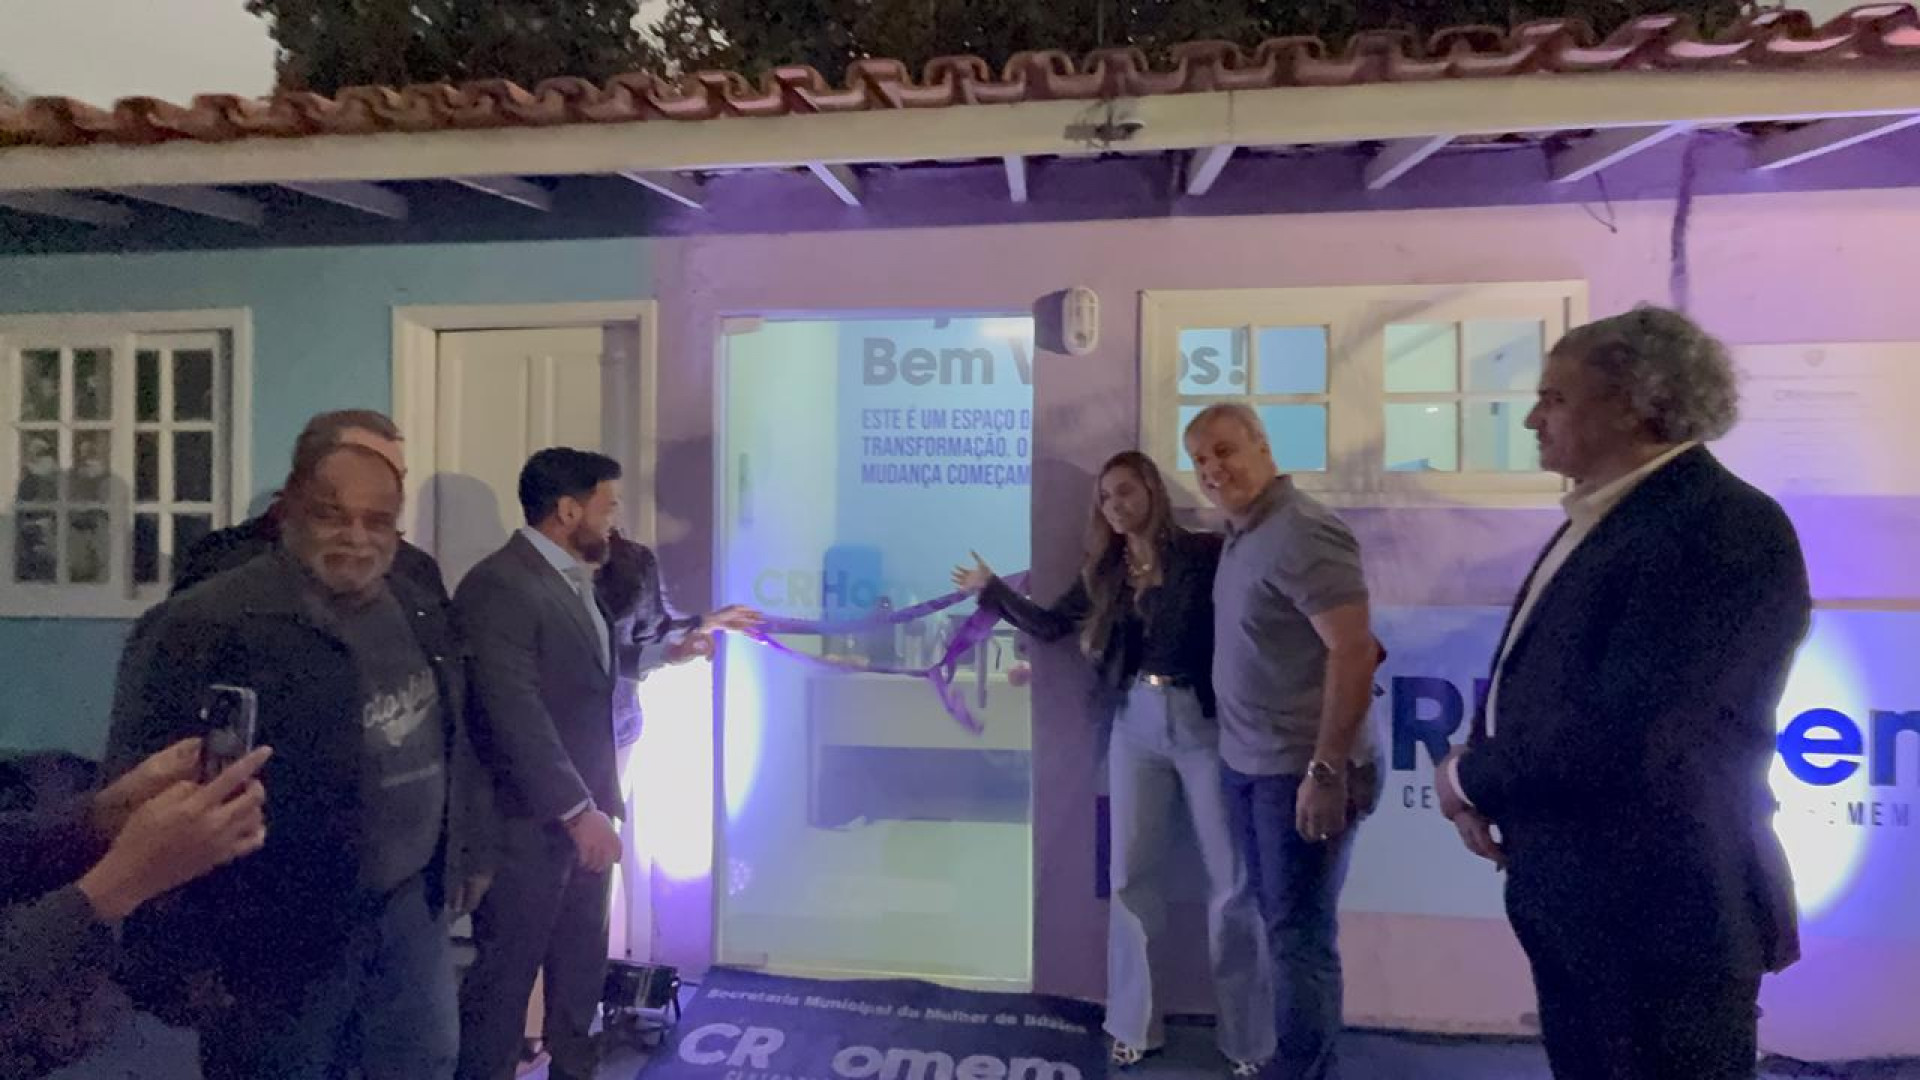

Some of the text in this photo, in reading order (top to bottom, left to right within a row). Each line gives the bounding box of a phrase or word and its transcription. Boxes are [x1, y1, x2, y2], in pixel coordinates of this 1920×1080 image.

[863, 337, 994, 386] Bem
[1181, 327, 1246, 386] s!
[863, 408, 901, 430] ESTE
[907, 404, 918, 430] É
[921, 408, 947, 430] UM
[952, 408, 1015, 433] ESPAÇO
[863, 432, 1010, 460] TRANSFORMAÇÃO.
[863, 464, 1032, 489] MUDANÇA COMEÇAM
[1403, 785, 1433, 808] CE
